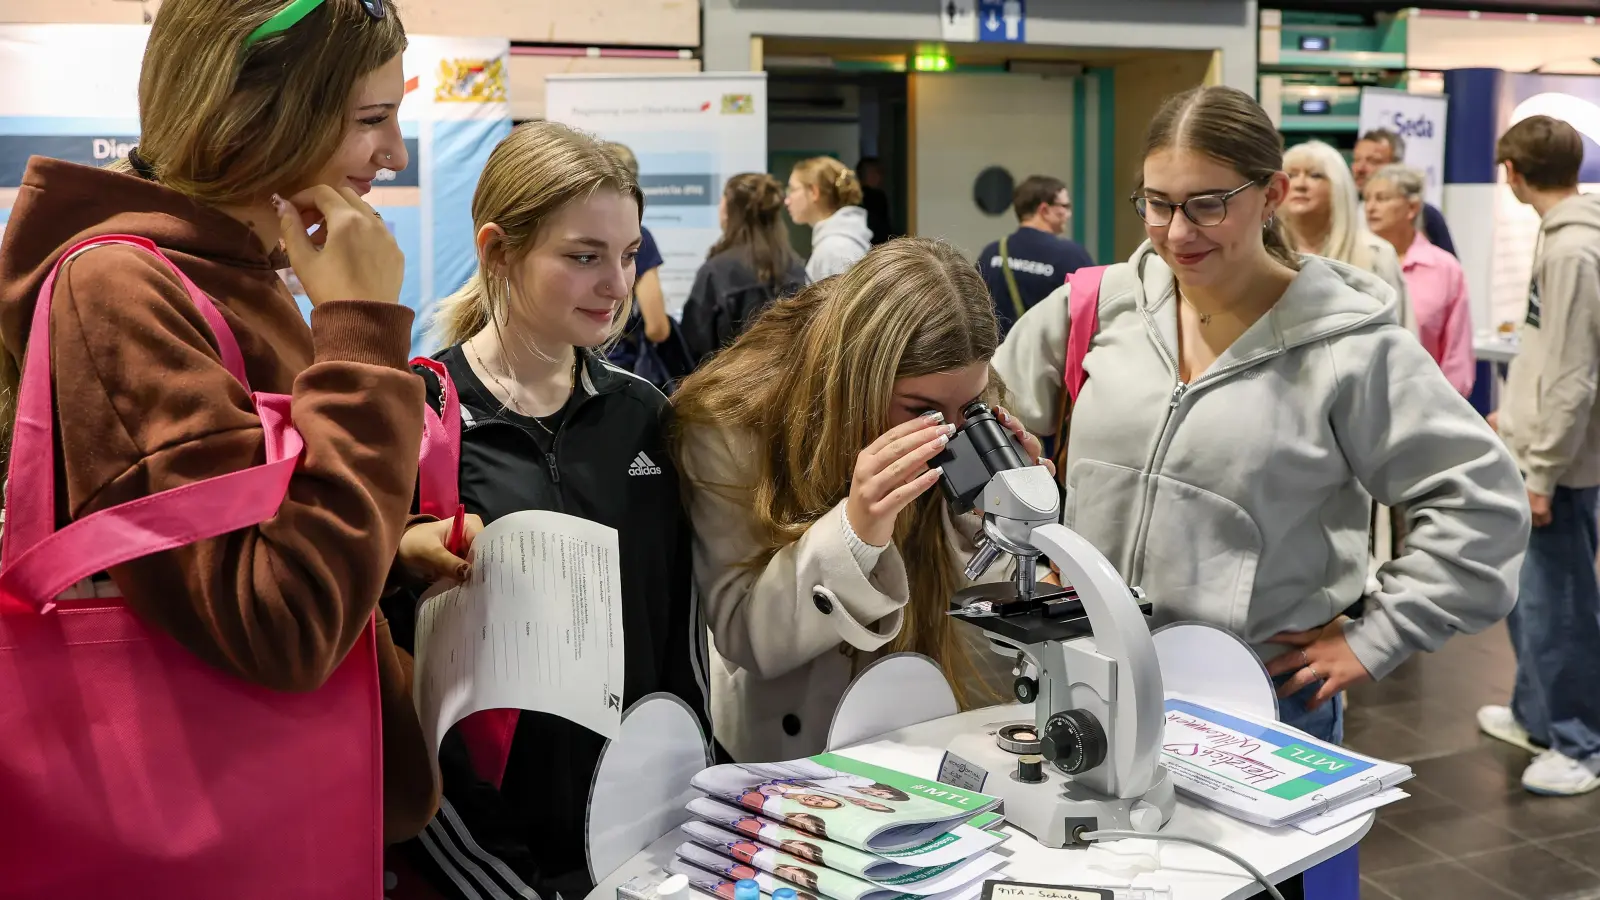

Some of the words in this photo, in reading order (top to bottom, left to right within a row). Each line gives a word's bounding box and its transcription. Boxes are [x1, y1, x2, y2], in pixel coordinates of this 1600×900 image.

[628, 466, 662, 476] adidas
[1289, 747, 1345, 772] MTL
[910, 783, 971, 806] #MTL
